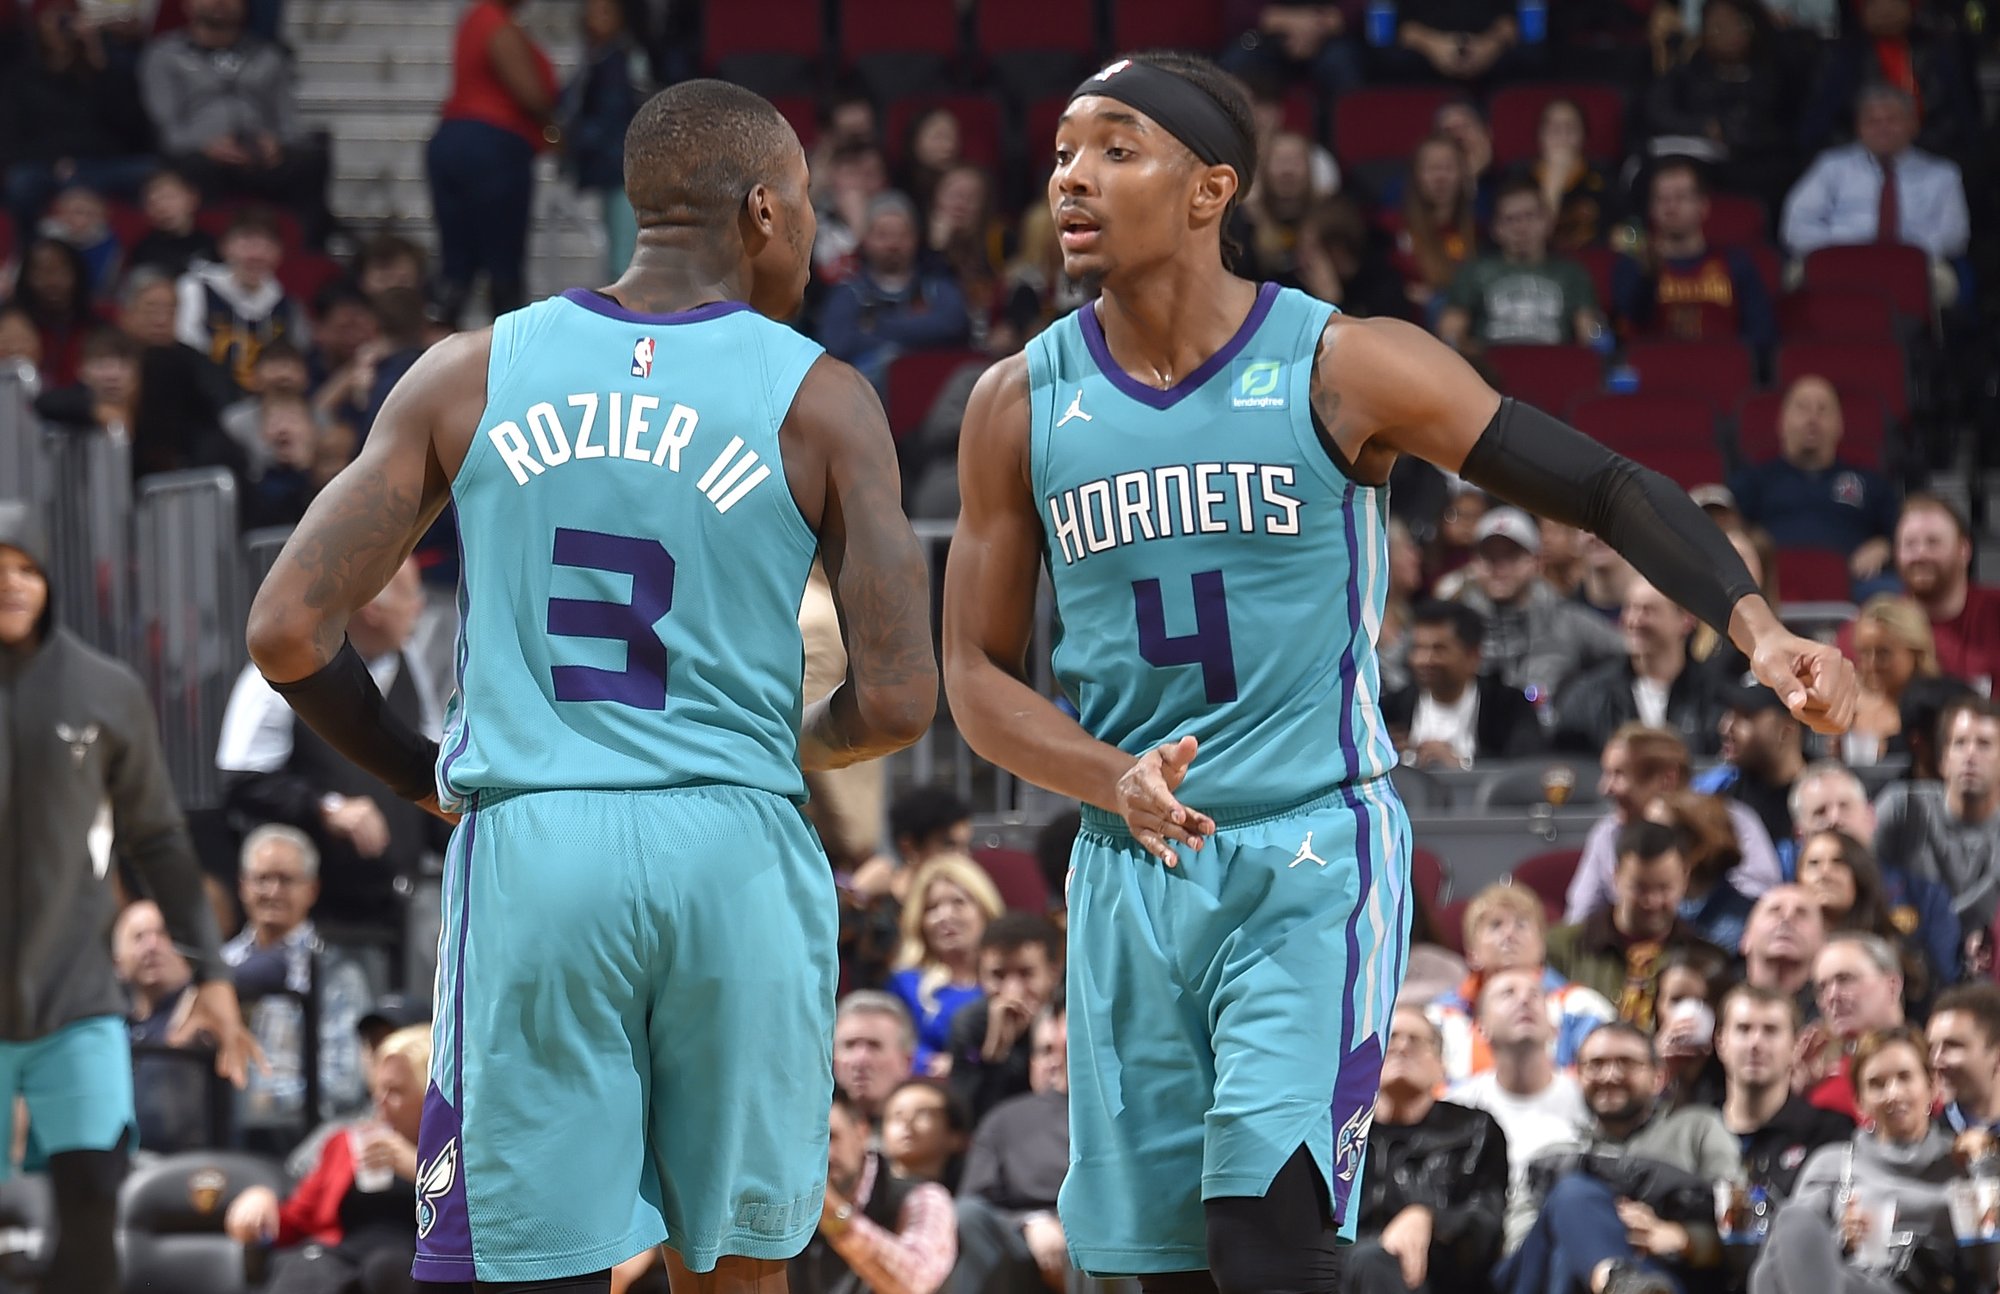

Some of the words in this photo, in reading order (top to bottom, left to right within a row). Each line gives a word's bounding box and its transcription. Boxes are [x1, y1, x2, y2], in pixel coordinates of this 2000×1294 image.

[487, 392, 699, 486] ROZIER
[696, 435, 771, 514] III
[1233, 397, 1284, 408] lendingtree
[1049, 462, 1307, 566] HORNETS
[547, 527, 676, 711] 3
[1131, 569, 1238, 705] 4
